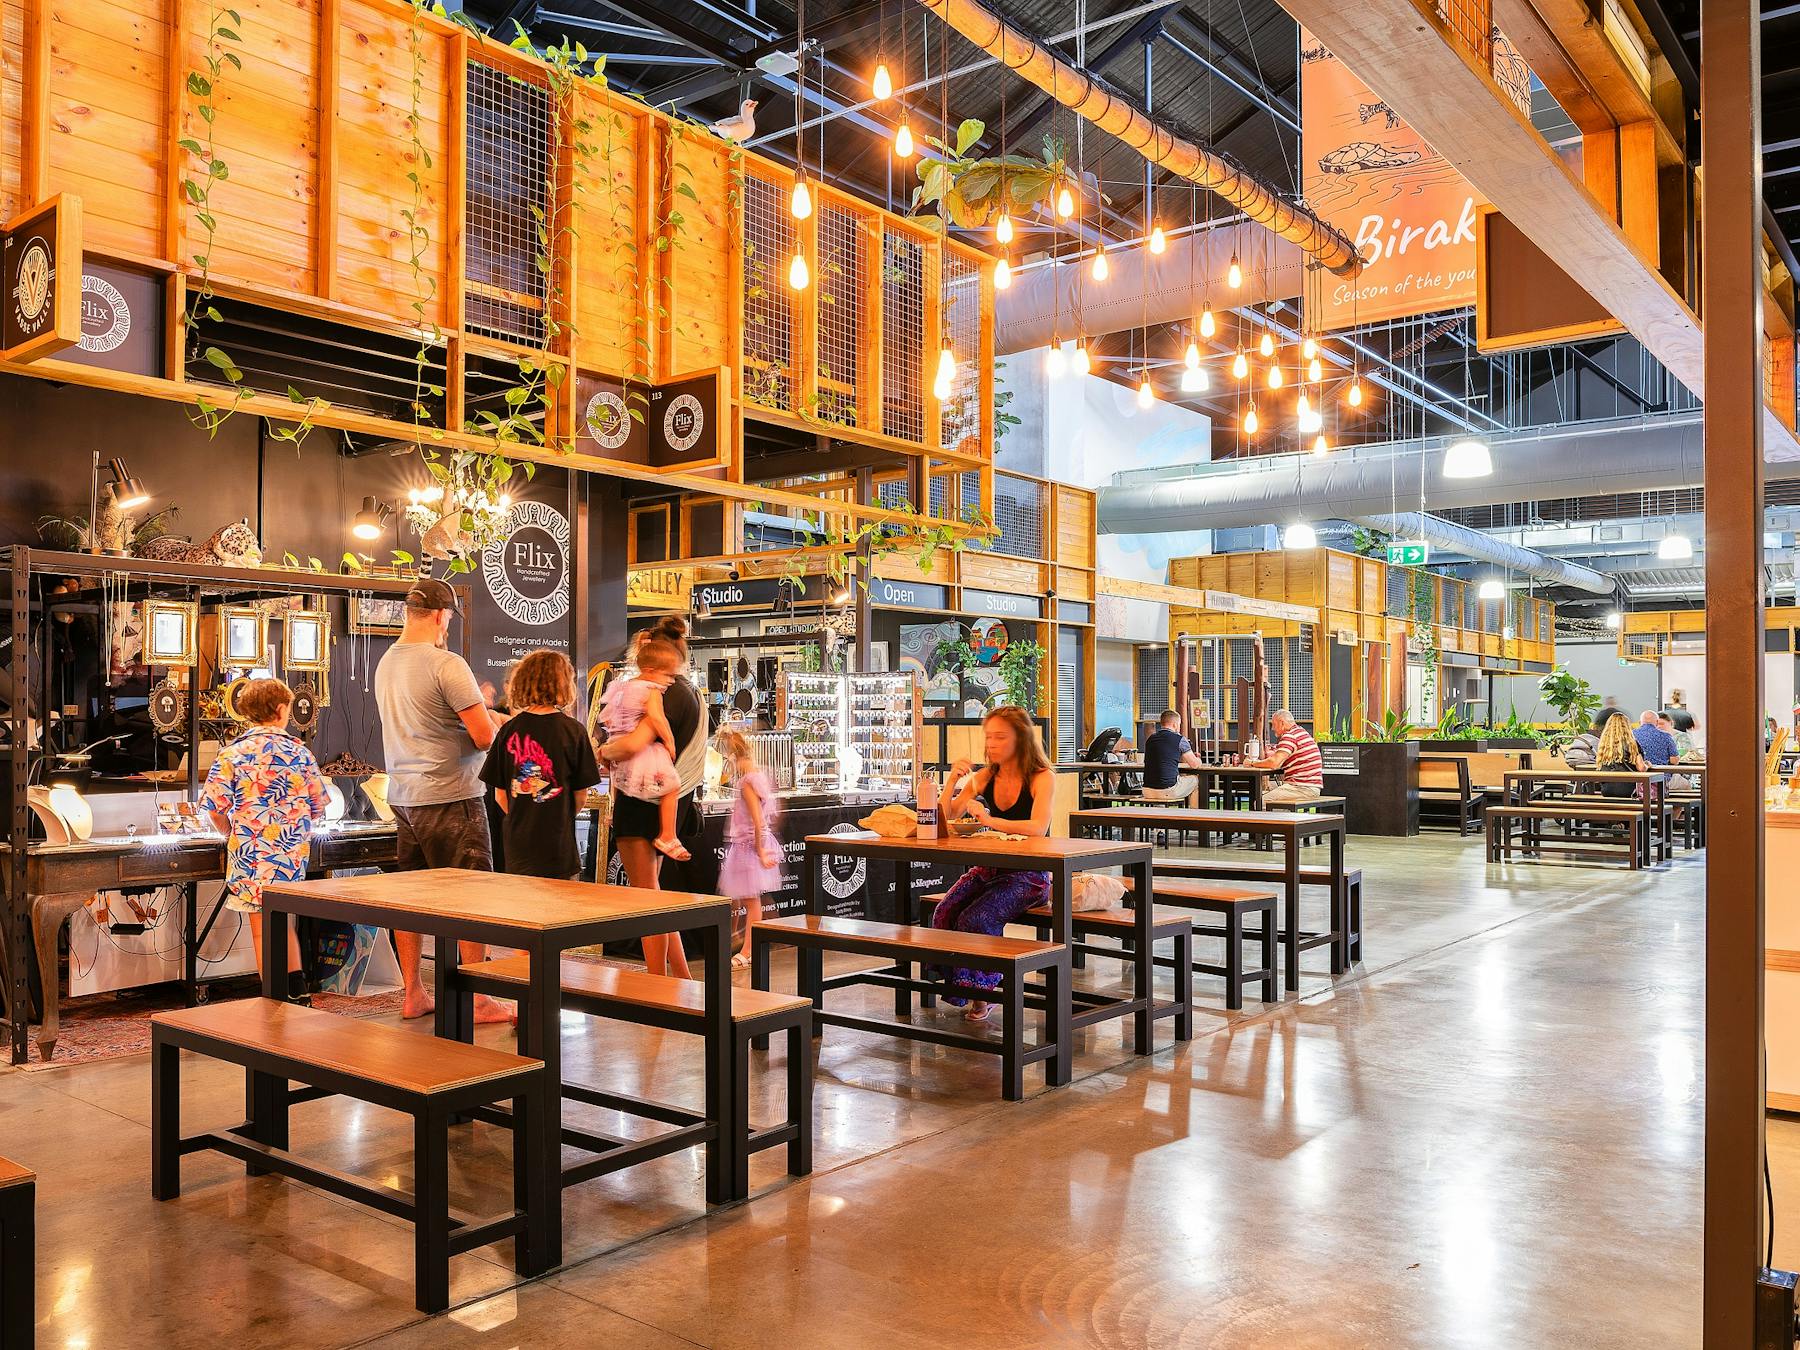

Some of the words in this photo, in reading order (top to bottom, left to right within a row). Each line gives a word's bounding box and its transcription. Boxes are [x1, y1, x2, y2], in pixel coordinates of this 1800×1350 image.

[1354, 197, 1476, 269] Birak
[1333, 284, 1389, 306] Season
[1394, 274, 1413, 295] of
[1416, 272, 1442, 290] the
[15, 304, 31, 334] VASSE
[32, 290, 53, 333] VALLEY
[652, 391, 663, 401] 113
[675, 413, 693, 426] Flix
[512, 542, 557, 570] Flix
[516, 567, 551, 577] Handcrafted
[522, 576, 546, 584] Jewellery
[637, 568, 683, 596] ALLEY
[703, 585, 743, 604] Studio
[884, 583, 915, 605] Open
[986, 594, 1017, 612] Studio
[768, 625, 788, 634] OPEN
[493, 635, 526, 646] Designed
[527, 637, 541, 646] and
[542, 638, 562, 647] Made
